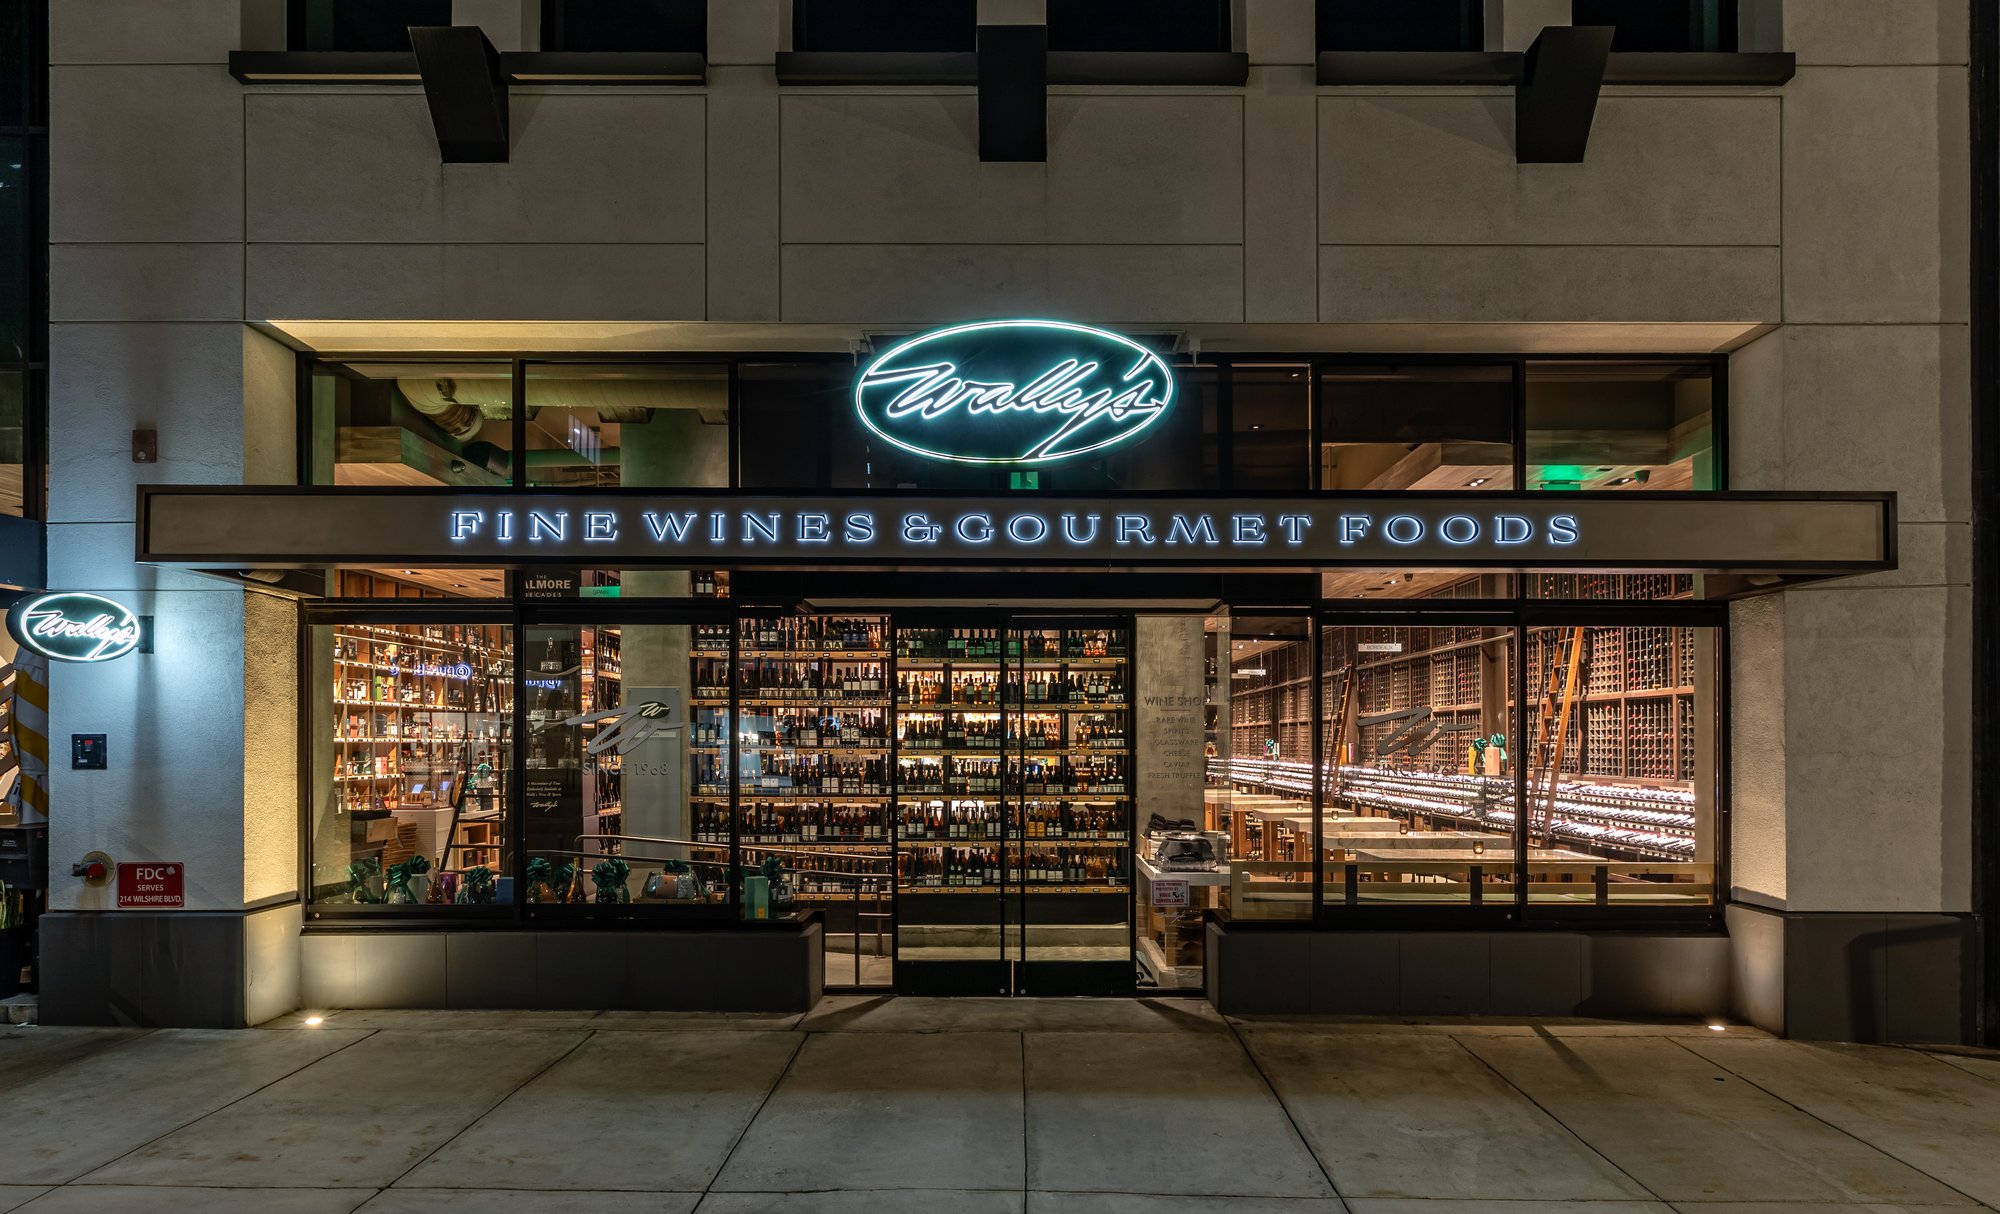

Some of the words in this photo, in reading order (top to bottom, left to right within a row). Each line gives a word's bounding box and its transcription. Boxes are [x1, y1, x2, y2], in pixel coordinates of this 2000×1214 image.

[861, 352, 1165, 460] Wally's
[450, 511, 620, 542] FINE
[642, 512, 876, 542] WINES
[955, 513, 1313, 544] GOURMET
[1339, 514, 1580, 545] FOODS
[26, 609, 138, 659] Wally's
[1144, 696, 1174, 706] WINE
[136, 867, 164, 880] FDC
[137, 884, 164, 892] SERVES
[119, 895, 132, 903] 214
[133, 895, 163, 903] WILSHIRE
